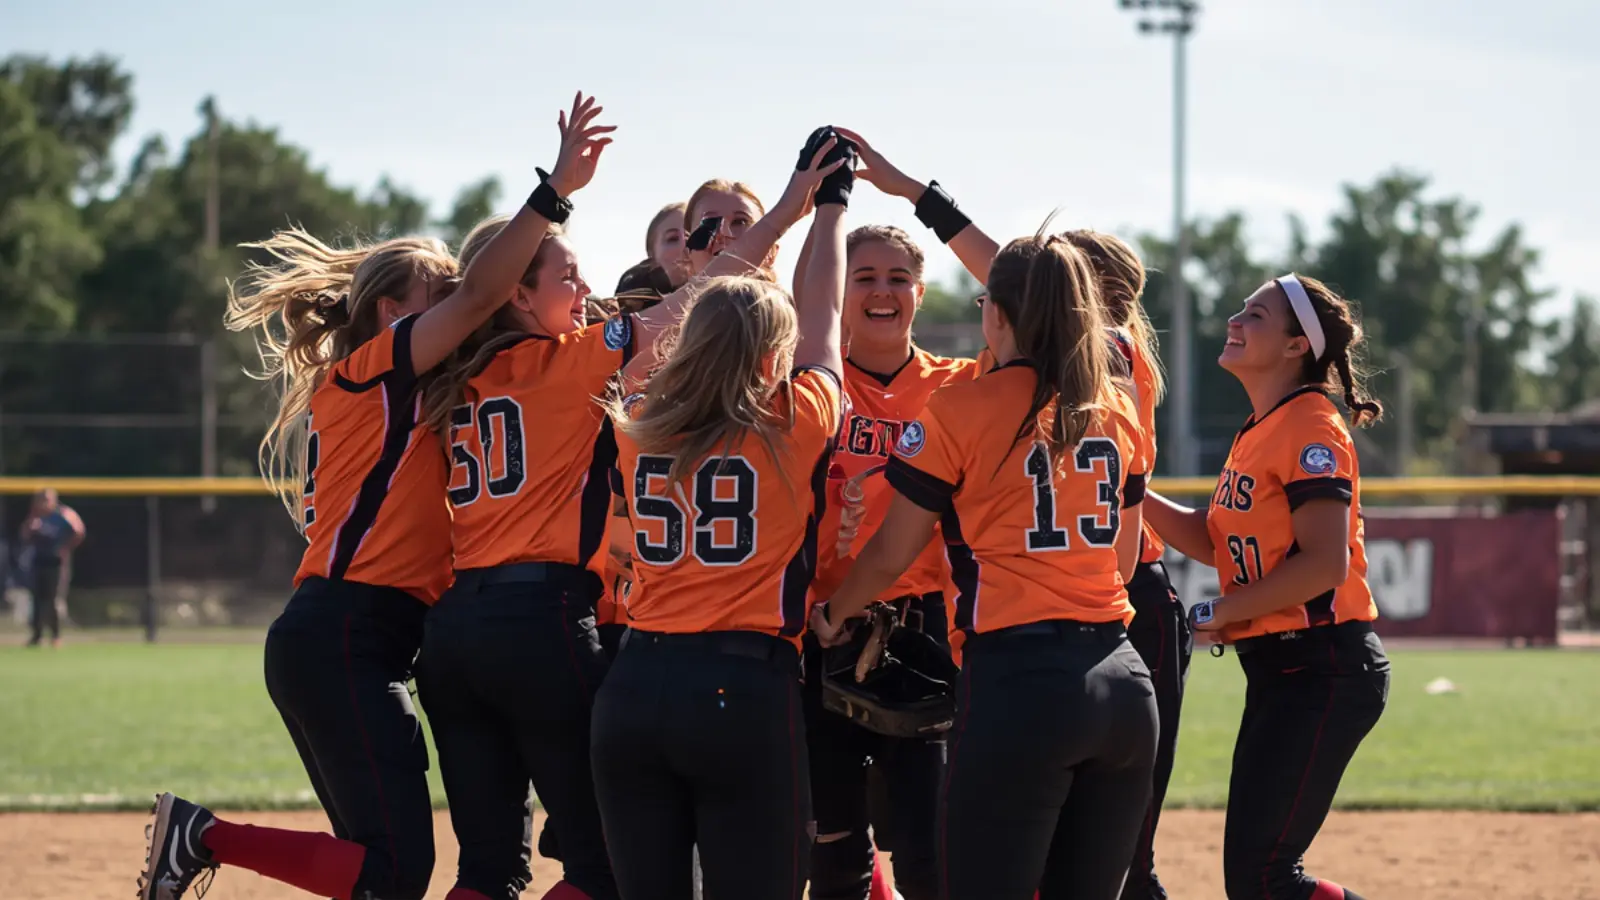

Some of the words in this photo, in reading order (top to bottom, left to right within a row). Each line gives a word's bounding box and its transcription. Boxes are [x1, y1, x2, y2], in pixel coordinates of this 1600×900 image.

[448, 396, 527, 508] 50
[1024, 437, 1122, 552] 13
[635, 453, 758, 566] 58
